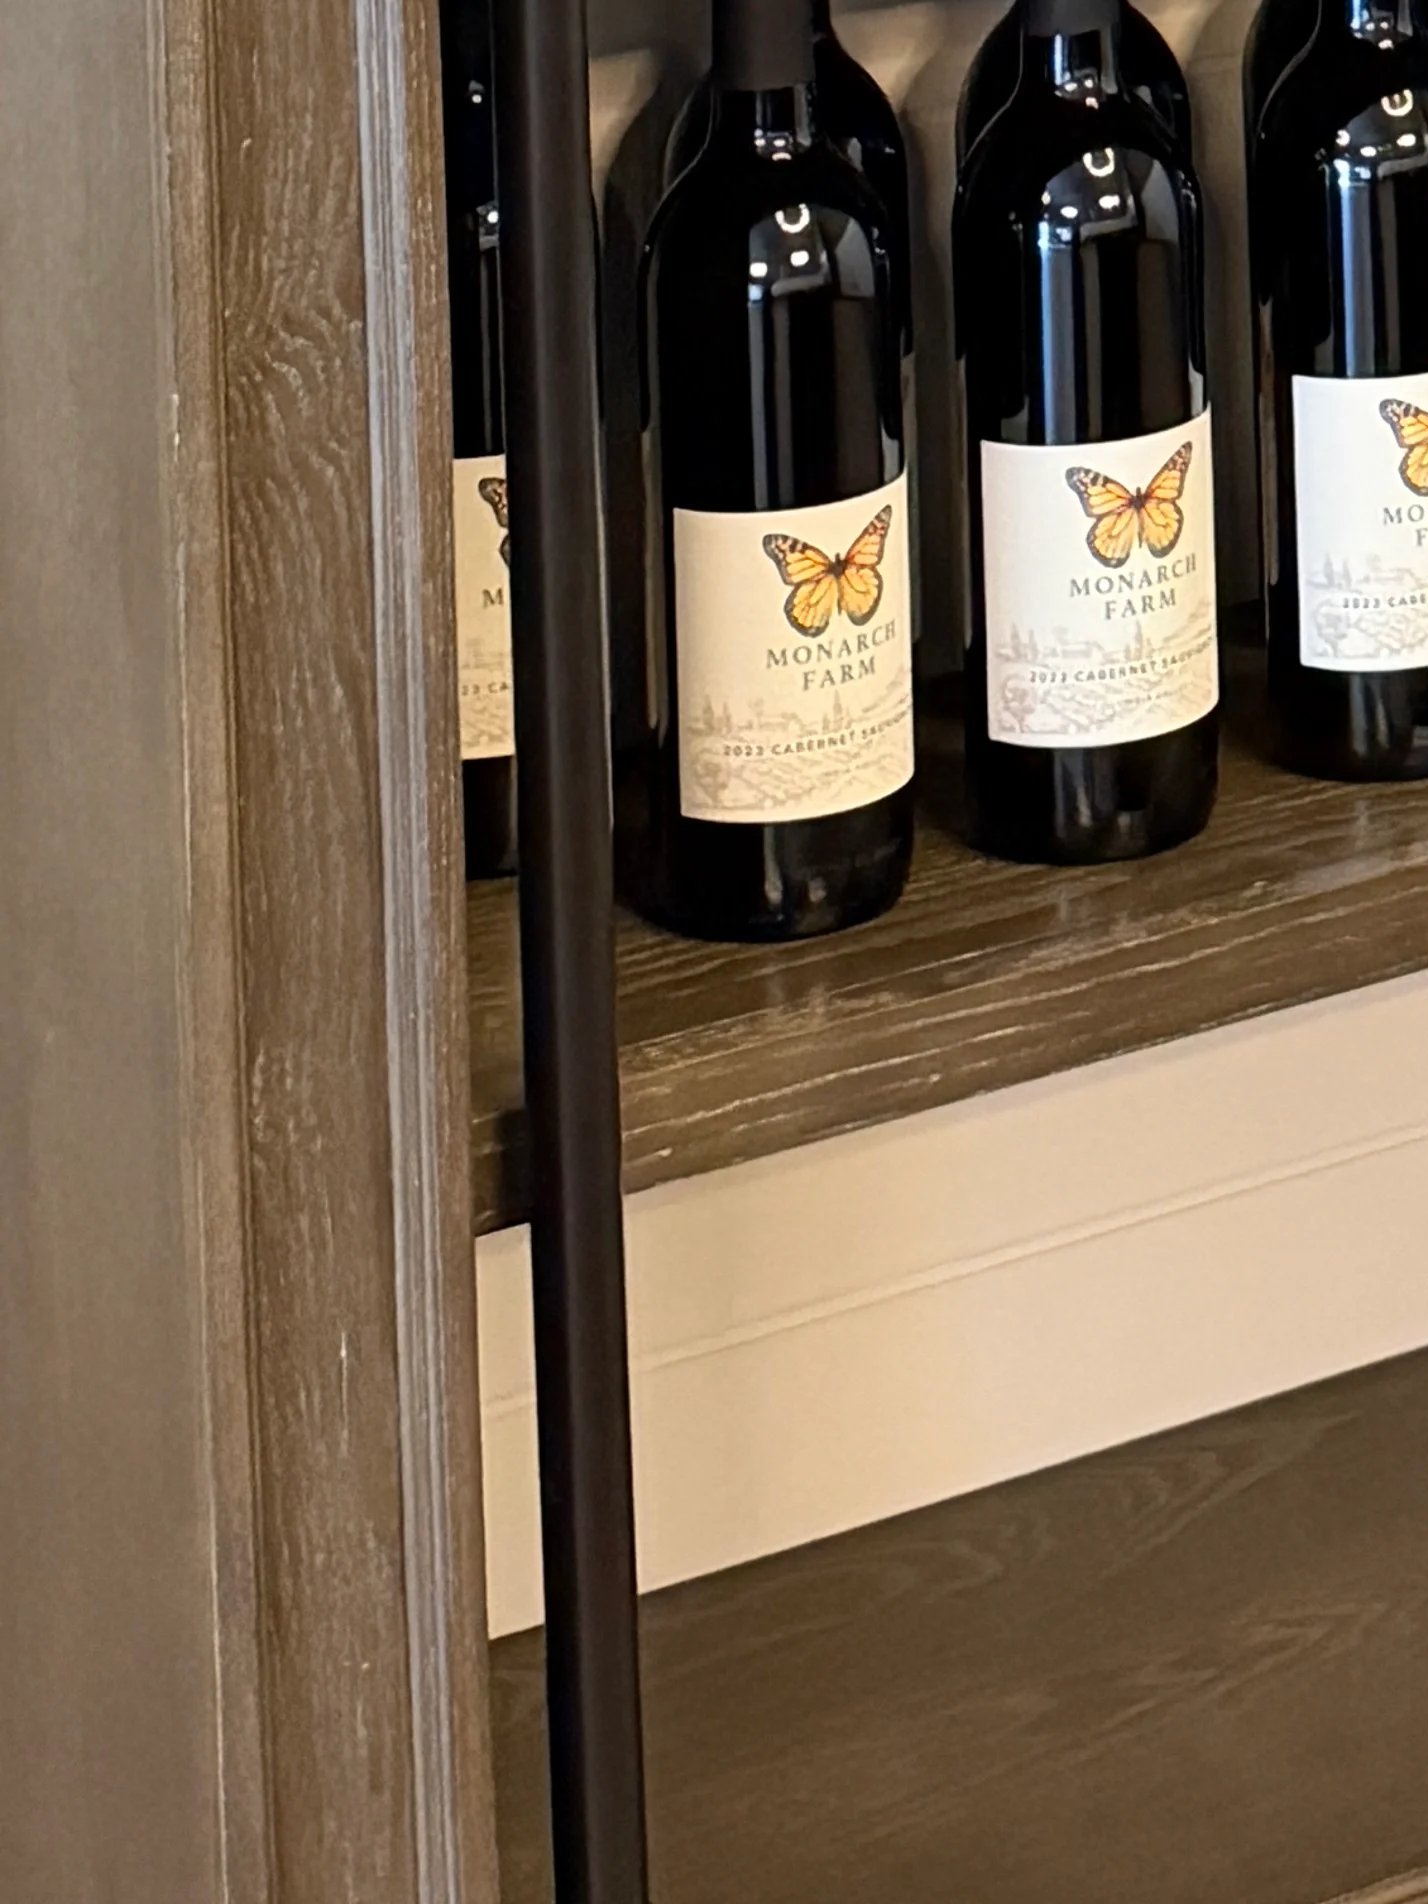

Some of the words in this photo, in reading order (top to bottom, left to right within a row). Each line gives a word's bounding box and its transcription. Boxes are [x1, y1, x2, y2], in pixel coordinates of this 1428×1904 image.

[1068, 552, 1197, 598] MONARCH
[1104, 588, 1176, 621] FARM
[765, 620, 897, 670] MONARCH
[802, 656, 876, 692] FARM
[1073, 658, 1158, 683] CABERNET
[723, 743, 765, 757] 2023
[771, 730, 857, 756] CABERNET
